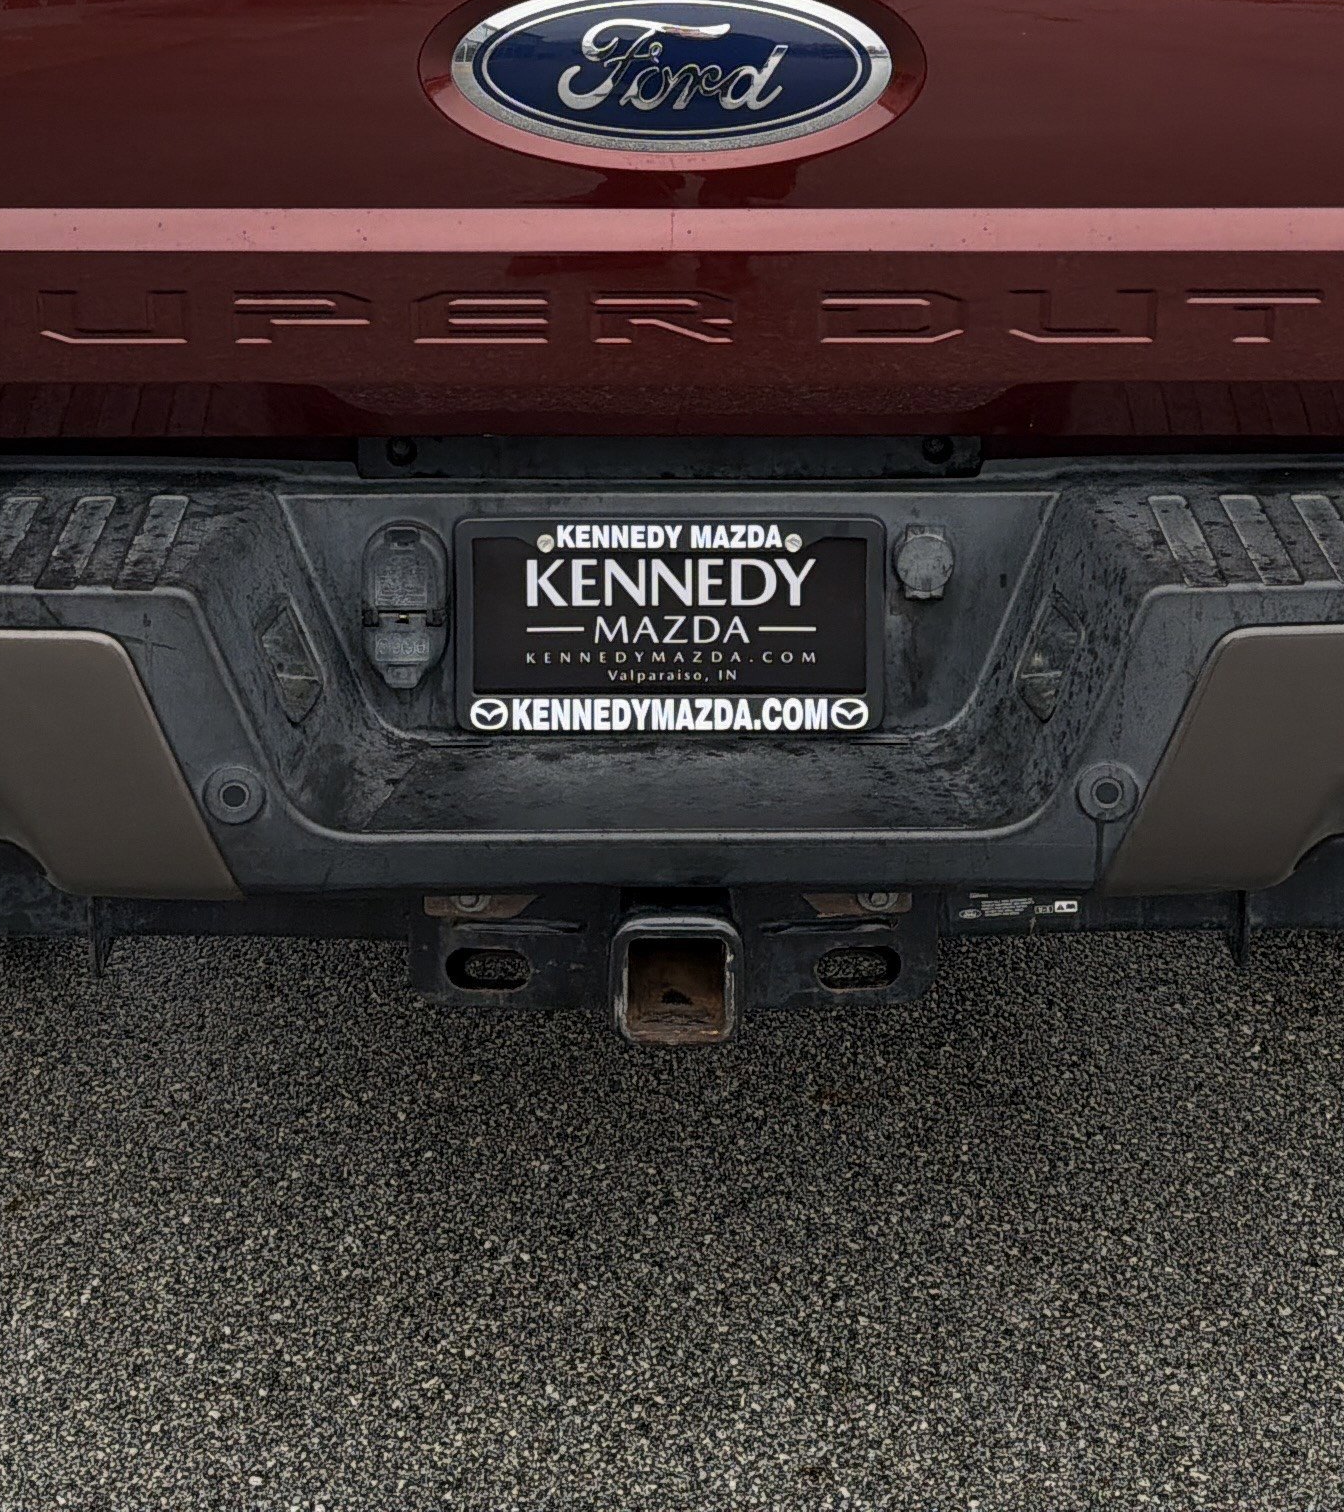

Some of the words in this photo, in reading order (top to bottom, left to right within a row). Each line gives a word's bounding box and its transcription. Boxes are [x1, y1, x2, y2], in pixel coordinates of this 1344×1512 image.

[557, 18, 789, 111] Ford
[556, 524, 682, 550] KENNEDY
[690, 524, 783, 550] MAZDA
[526, 558, 817, 608] KENNEDY
[594, 615, 751, 644] MAZDA
[525, 650, 818, 665] KENNEDYMAZDA.COM
[607, 669, 711, 684] Valparaiso,
[717, 669, 738, 682] IN
[512, 697, 829, 732] KENNEDYMAZDA.COM
